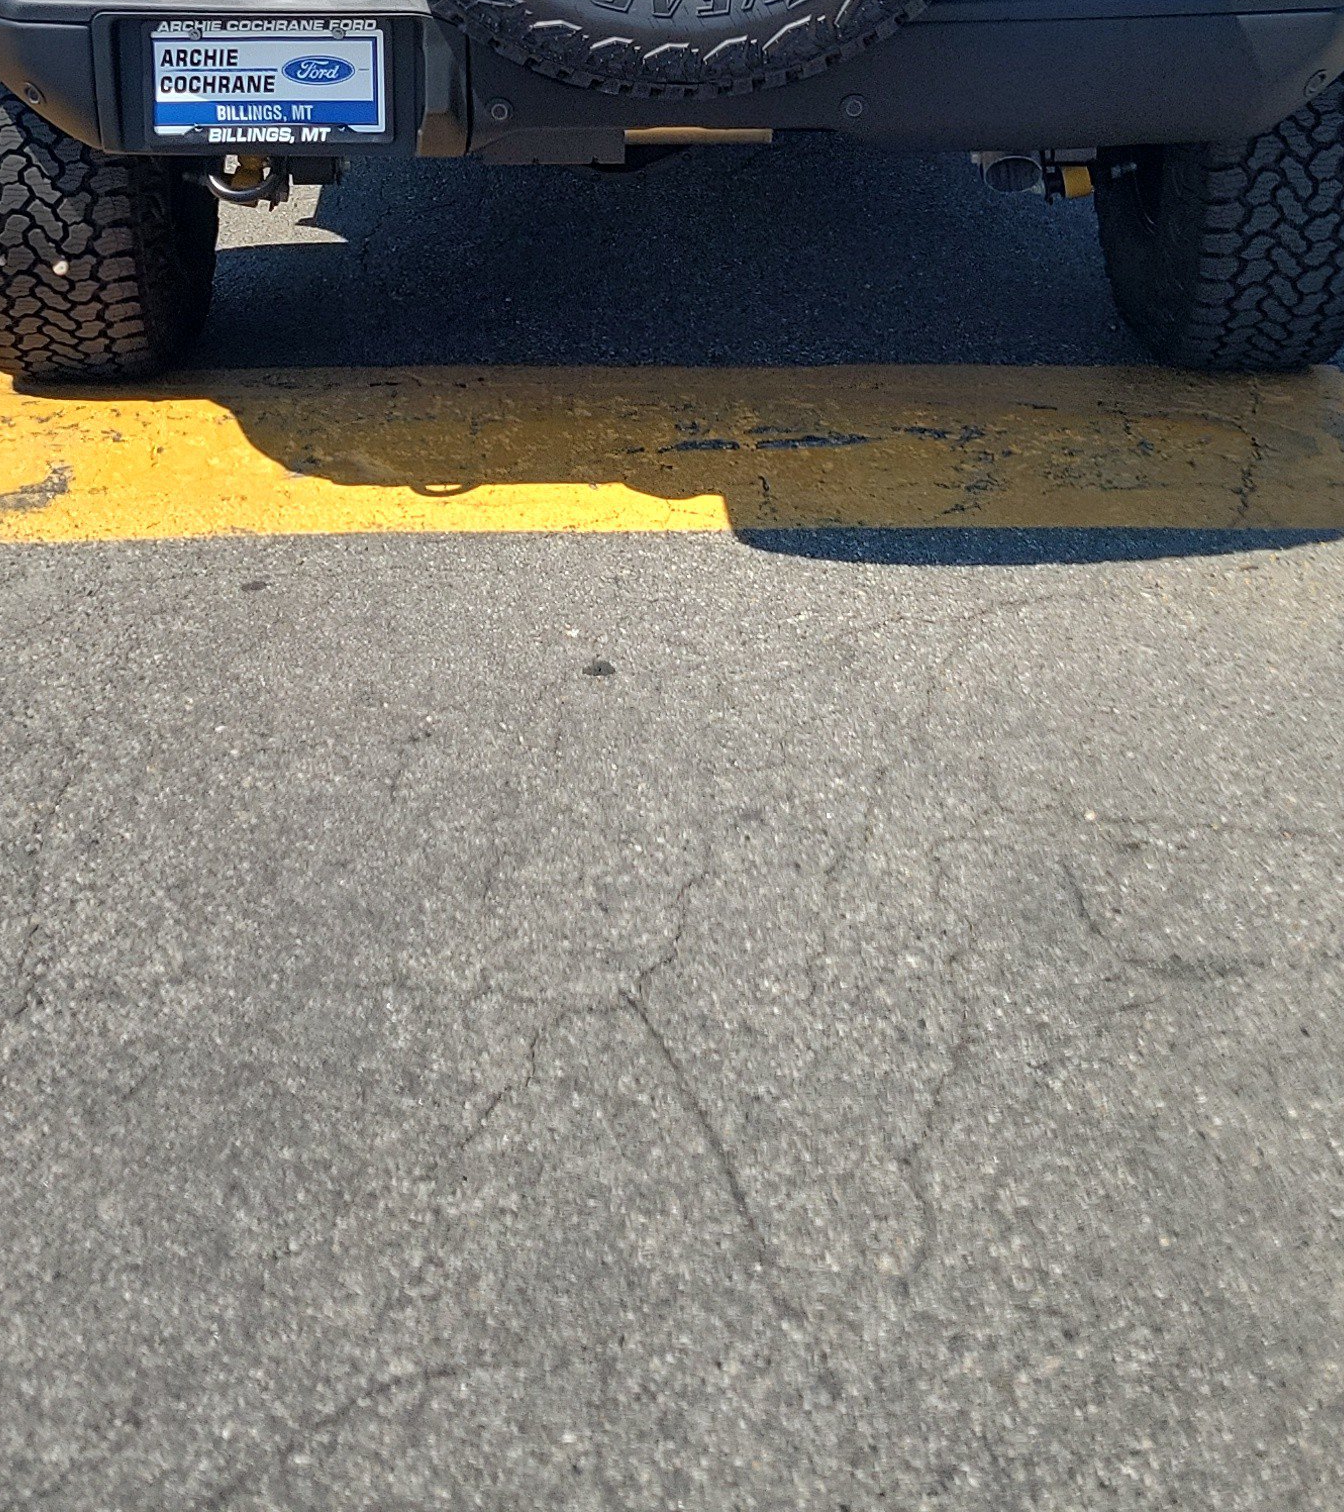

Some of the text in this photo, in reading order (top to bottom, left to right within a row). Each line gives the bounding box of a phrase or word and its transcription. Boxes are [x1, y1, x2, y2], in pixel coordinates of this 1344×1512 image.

[157, 19, 377, 33] ARCHIE COCHRANE FORD
[160, 48, 239, 68] ARCHIE
[296, 59, 339, 80] Ford
[160, 75, 276, 94] COCHRANE
[216, 104, 314, 123] BILLINGS, MT
[208, 128, 332, 144] BILLINGS, MT
